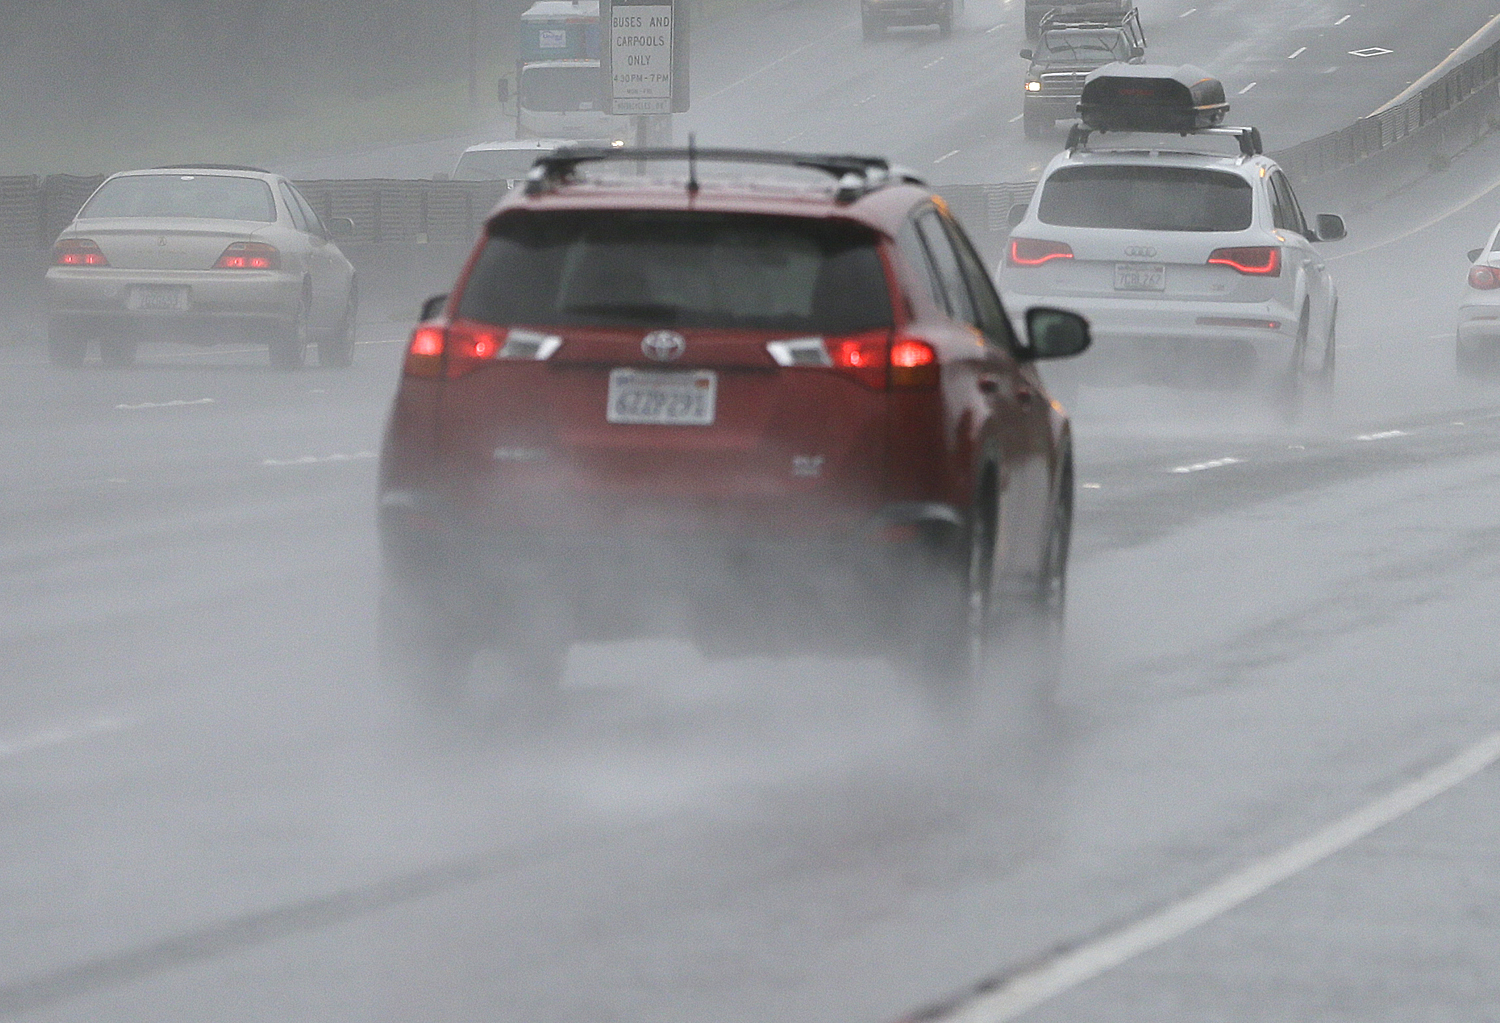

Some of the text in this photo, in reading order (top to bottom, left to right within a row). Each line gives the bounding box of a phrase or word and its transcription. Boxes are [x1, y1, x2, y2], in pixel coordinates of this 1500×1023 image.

[613, 17, 670, 28] BUSES AND
[616, 36, 665, 47] CARPOOLS
[627, 55, 651, 66] ONLY
